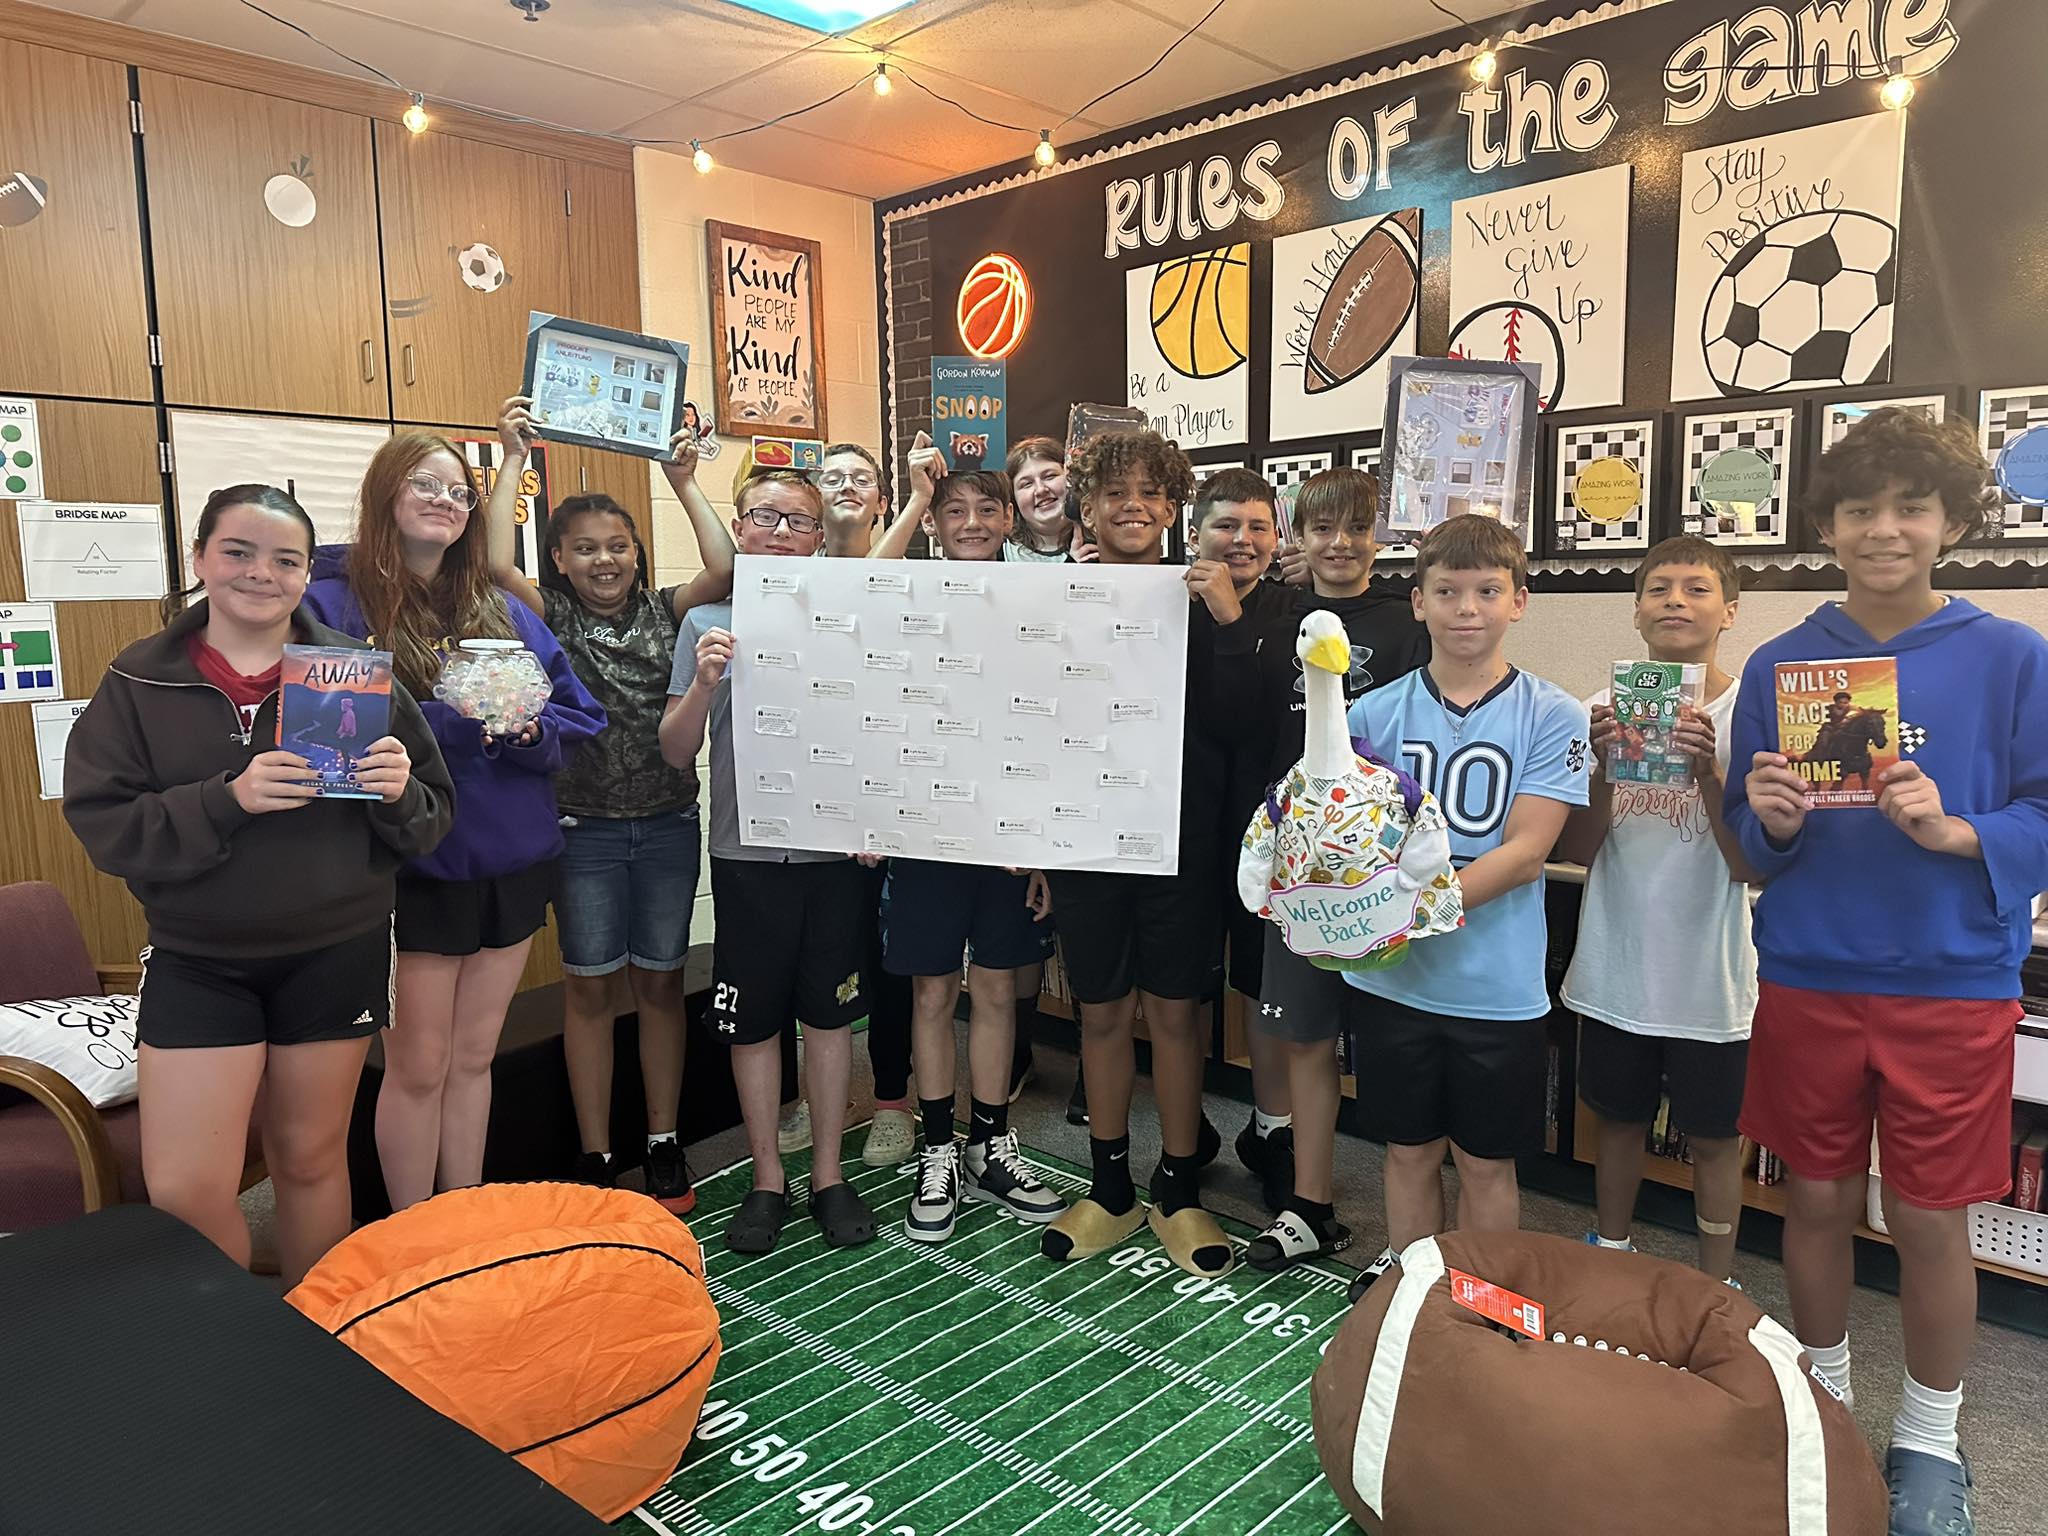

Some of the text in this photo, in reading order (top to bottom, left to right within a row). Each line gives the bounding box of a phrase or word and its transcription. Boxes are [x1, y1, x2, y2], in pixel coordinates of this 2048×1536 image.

[1663, 0, 1960, 126] game
[1466, 194, 1565, 248] Never
[728, 246, 802, 299] Kind
[744, 294, 797, 319] PEOPLE
[1279, 227, 1357, 369] Work Hard
[745, 314, 795, 334] ARE MY
[1555, 282, 1602, 344] Up
[731, 326, 801, 381] Kind
[738, 377, 749, 393] OF
[937, 367, 1000, 380] GORDON KORMAN
[1130, 373, 1148, 399] Be
[936, 394, 1002, 420] SNOOP
[1172, 404, 1233, 445] Player
[1580, 479, 1635, 489] AMAZING WORK
[1706, 471, 1769, 483] AMAZING WORK
[55, 509, 127, 519] BRIDGE MAP
[0, 610, 12, 619] AP
[304, 660, 375, 688] AWAY
[1638, 679, 1658, 687] tac
[1642, 672, 1659, 680] tic
[1780, 669, 1849, 693] WILL'S
[1783, 702, 1832, 724] RACE
[1786, 734, 1814, 750] FOR
[1281, 885, 1395, 923] Welcome
[1319, 916, 1377, 944] Back
[714, 982, 739, 1014] 27
[730, 1433, 808, 1482] 50
[796, 1482, 874, 1531] 40
